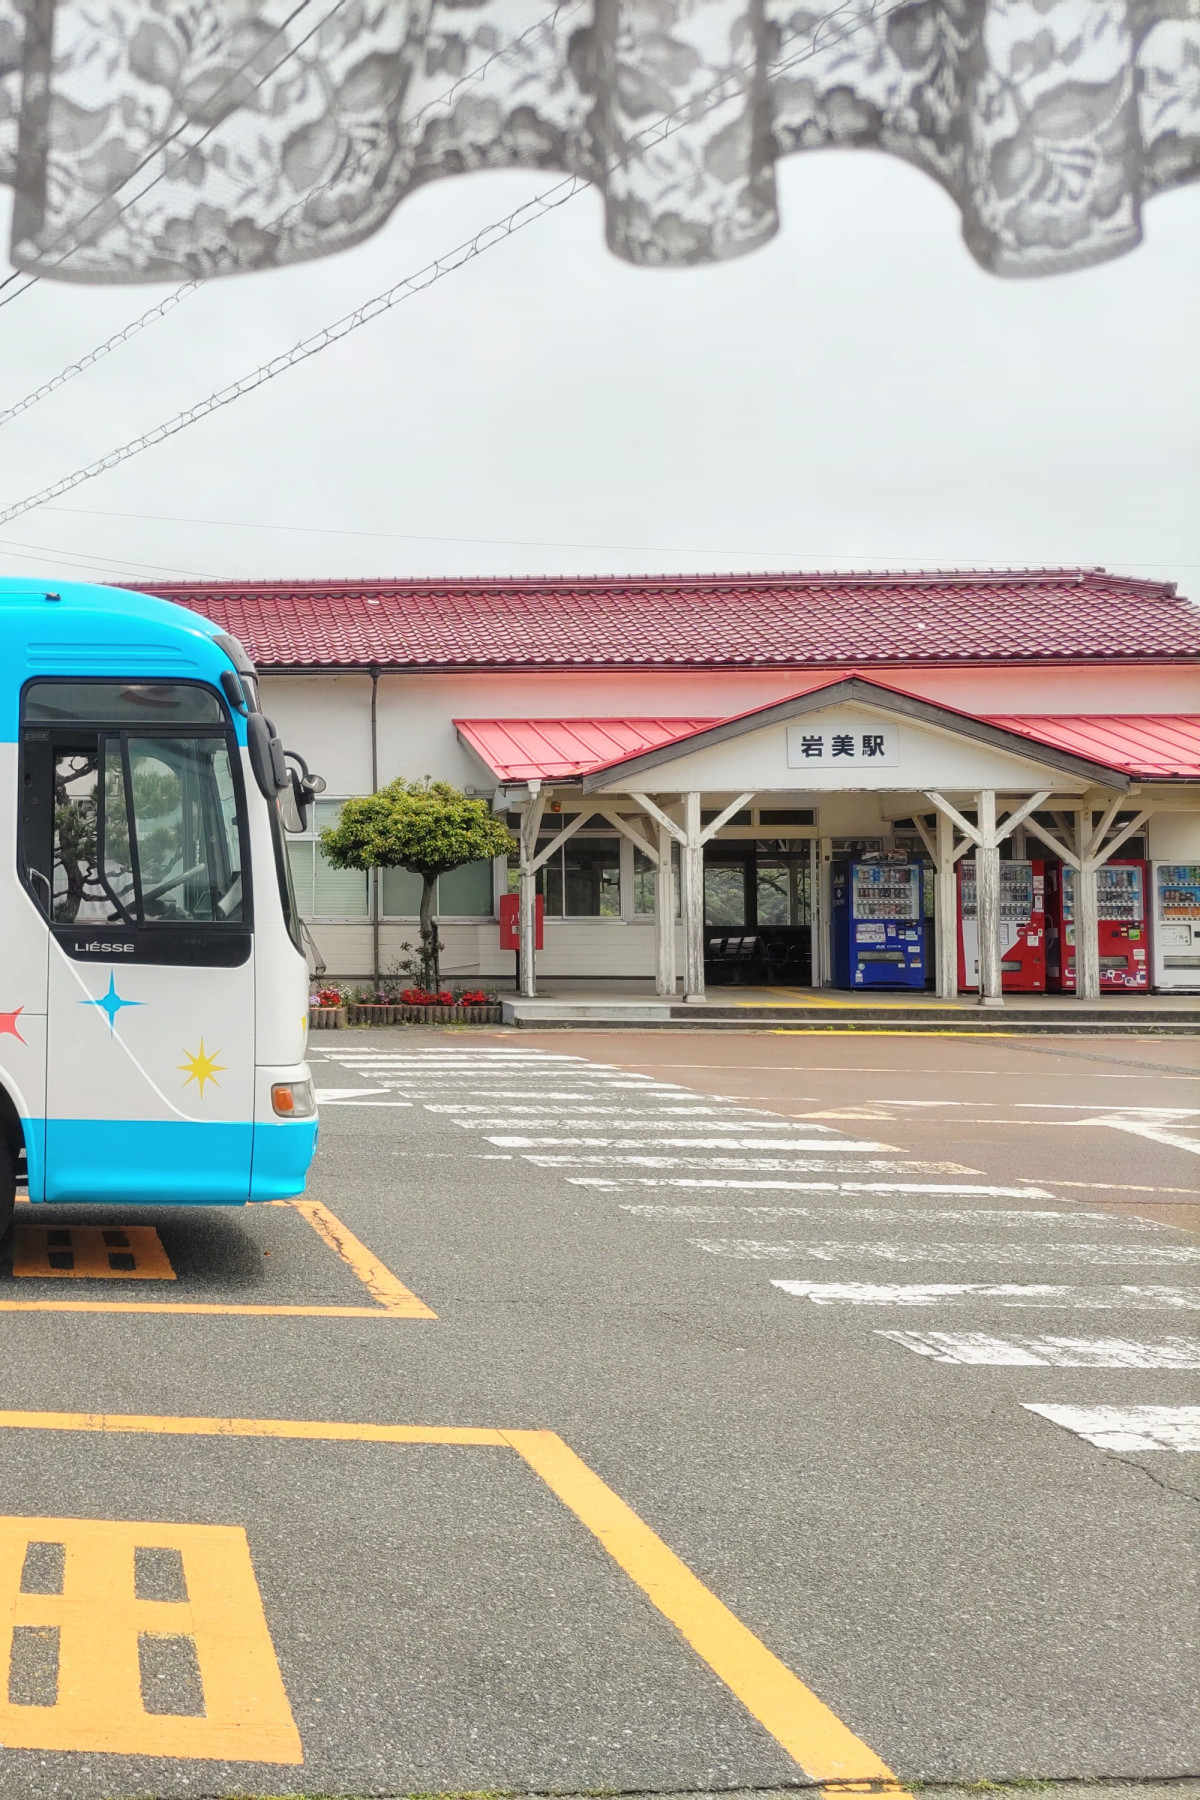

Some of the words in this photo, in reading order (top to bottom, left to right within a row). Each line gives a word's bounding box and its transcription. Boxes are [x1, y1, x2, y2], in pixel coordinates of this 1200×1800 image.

[801, 734, 885, 758] 岩美駅
[74, 941, 135, 953] LIÉSSE
